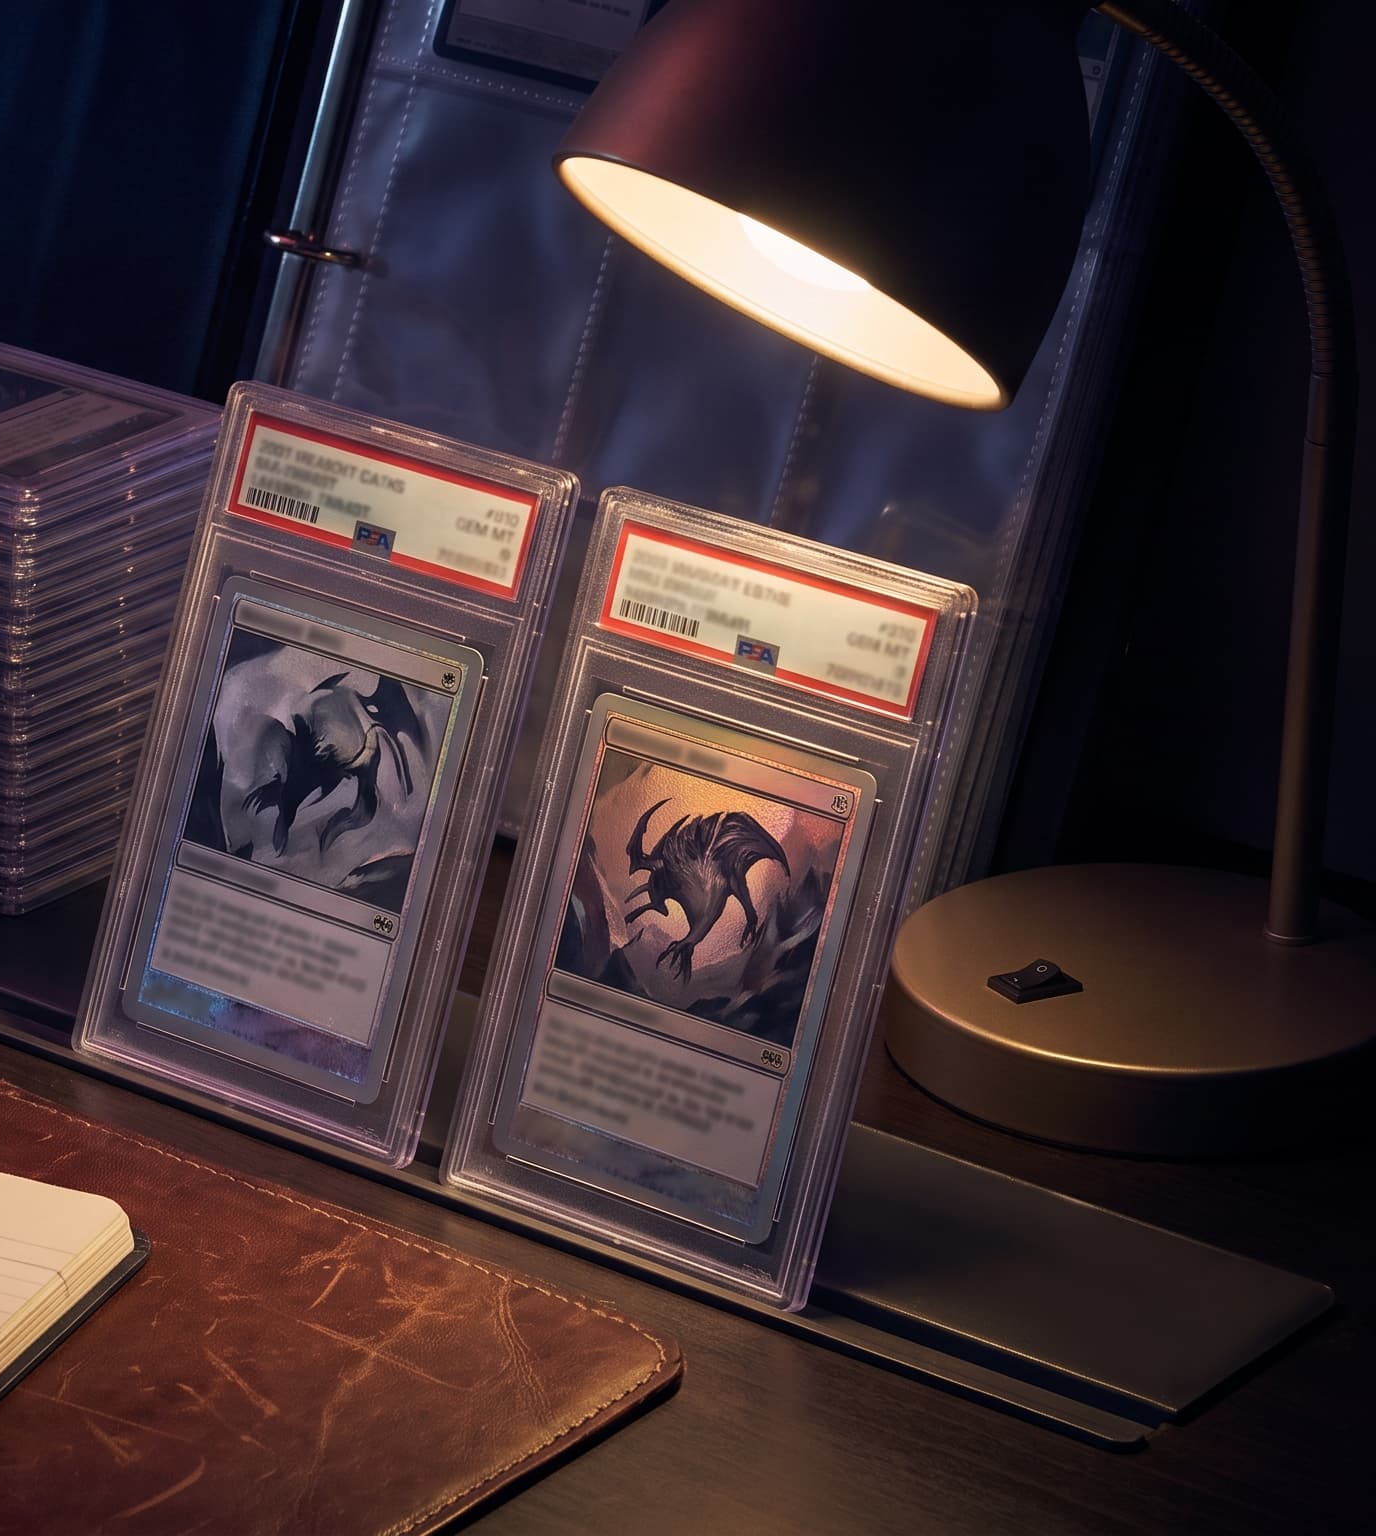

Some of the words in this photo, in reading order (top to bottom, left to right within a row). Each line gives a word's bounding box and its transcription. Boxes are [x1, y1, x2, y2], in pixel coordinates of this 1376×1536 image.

[356, 526, 390, 550] PSA
[455, 516, 489, 538] GEM
[491, 527, 516, 544] MT
[738, 640, 774, 666] PSA
